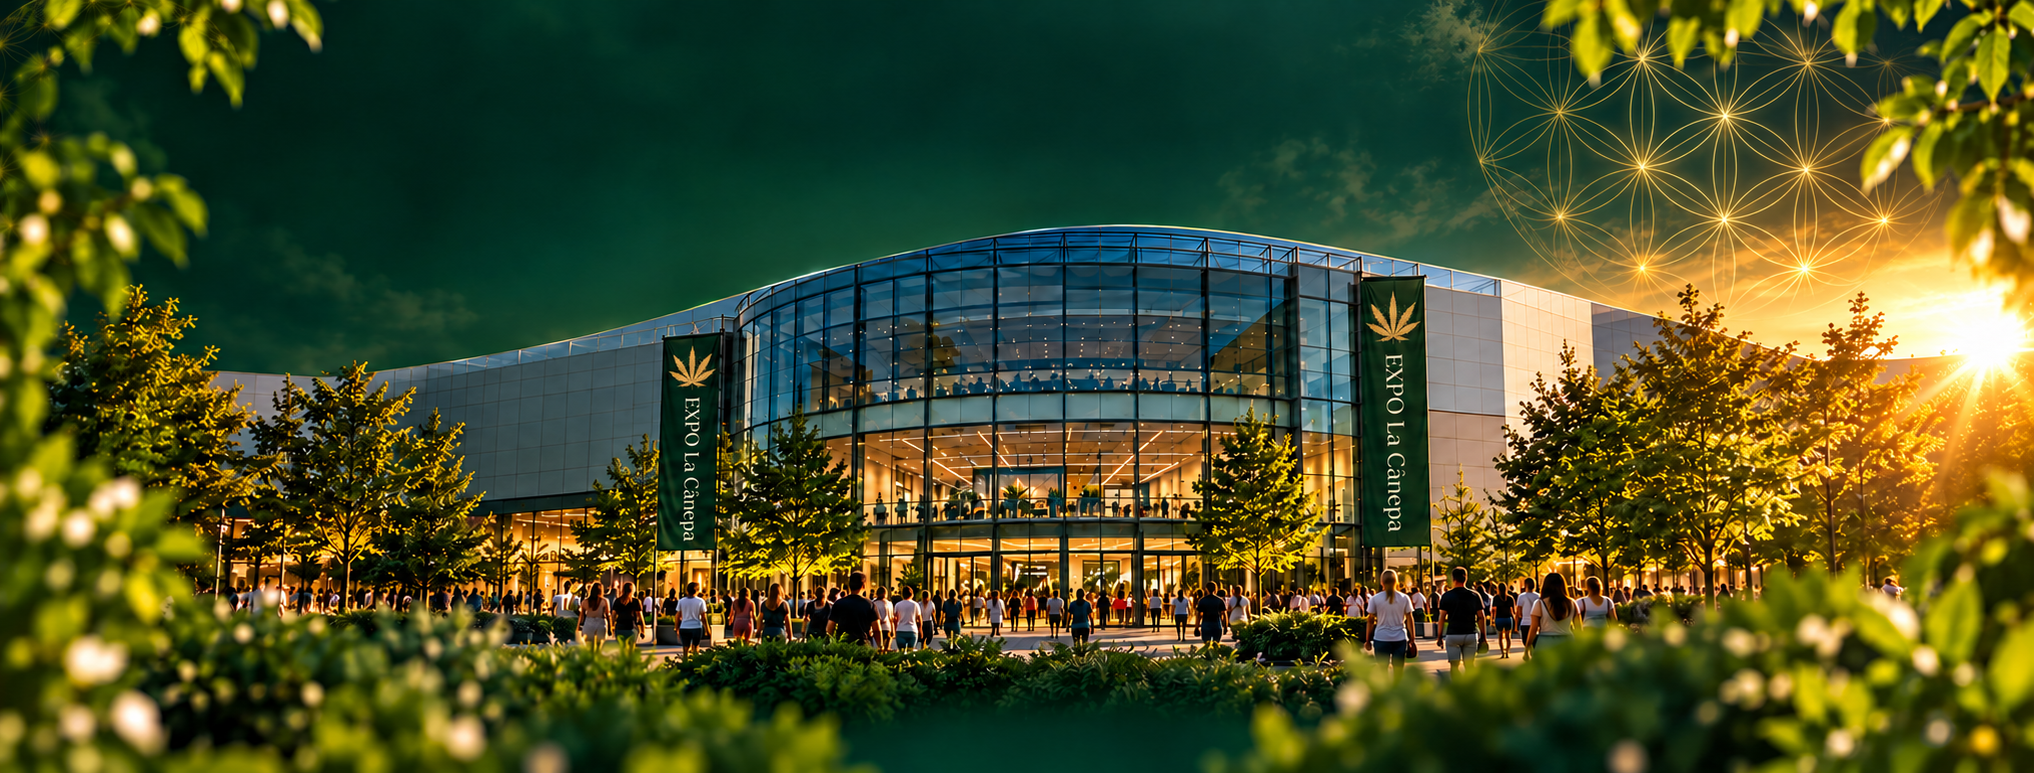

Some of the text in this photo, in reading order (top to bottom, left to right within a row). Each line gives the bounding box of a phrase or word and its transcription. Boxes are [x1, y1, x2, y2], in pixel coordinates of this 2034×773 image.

[679, 397, 700, 542] EXPO La Cânepa
[1382, 354, 1406, 532] EXPO La Cânepa
